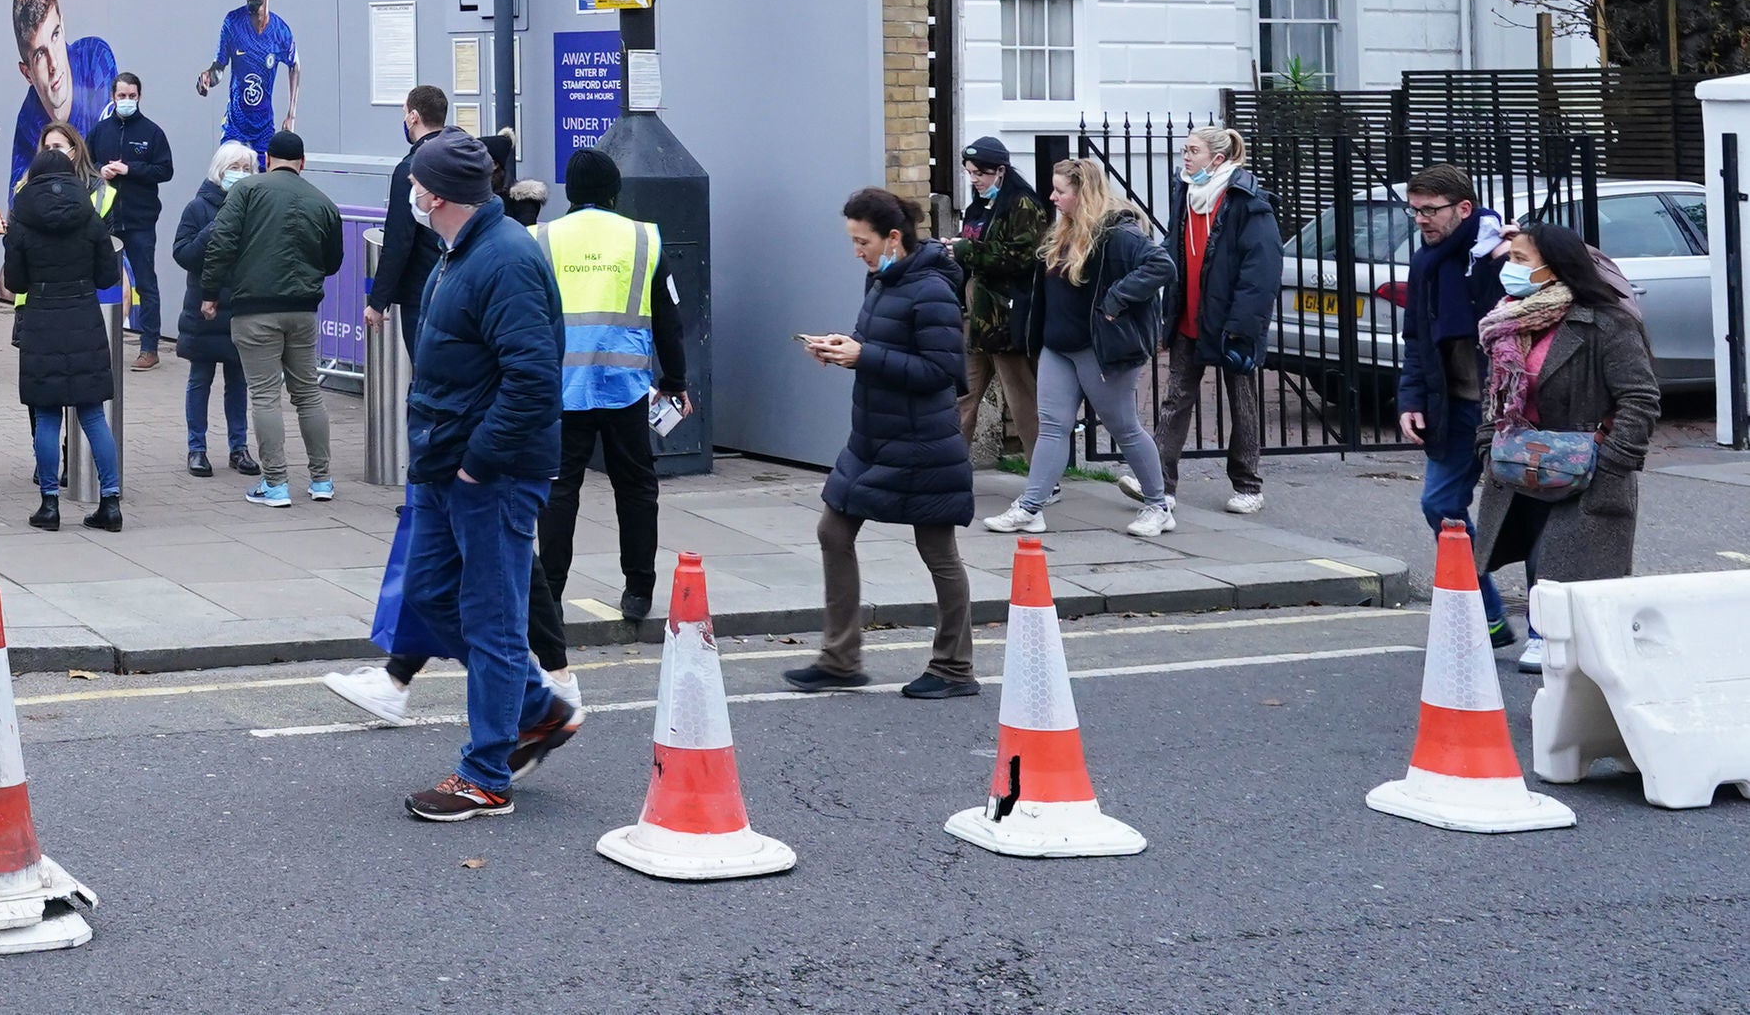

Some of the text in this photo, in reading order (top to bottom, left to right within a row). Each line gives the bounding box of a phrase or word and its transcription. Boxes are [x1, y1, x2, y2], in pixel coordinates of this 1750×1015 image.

[562, 52, 620, 65] AWAY FANS
[575, 68, 607, 77] ENTER BY
[562, 80, 621, 89] STAMFORD GATE
[570, 92, 614, 100] OPEN 24 HOURS
[563, 117, 599, 130] UNDER
[585, 253, 602, 261] H&F
[564, 265, 621, 273] COVID PATROL
[319, 320, 350, 338] KEEP
